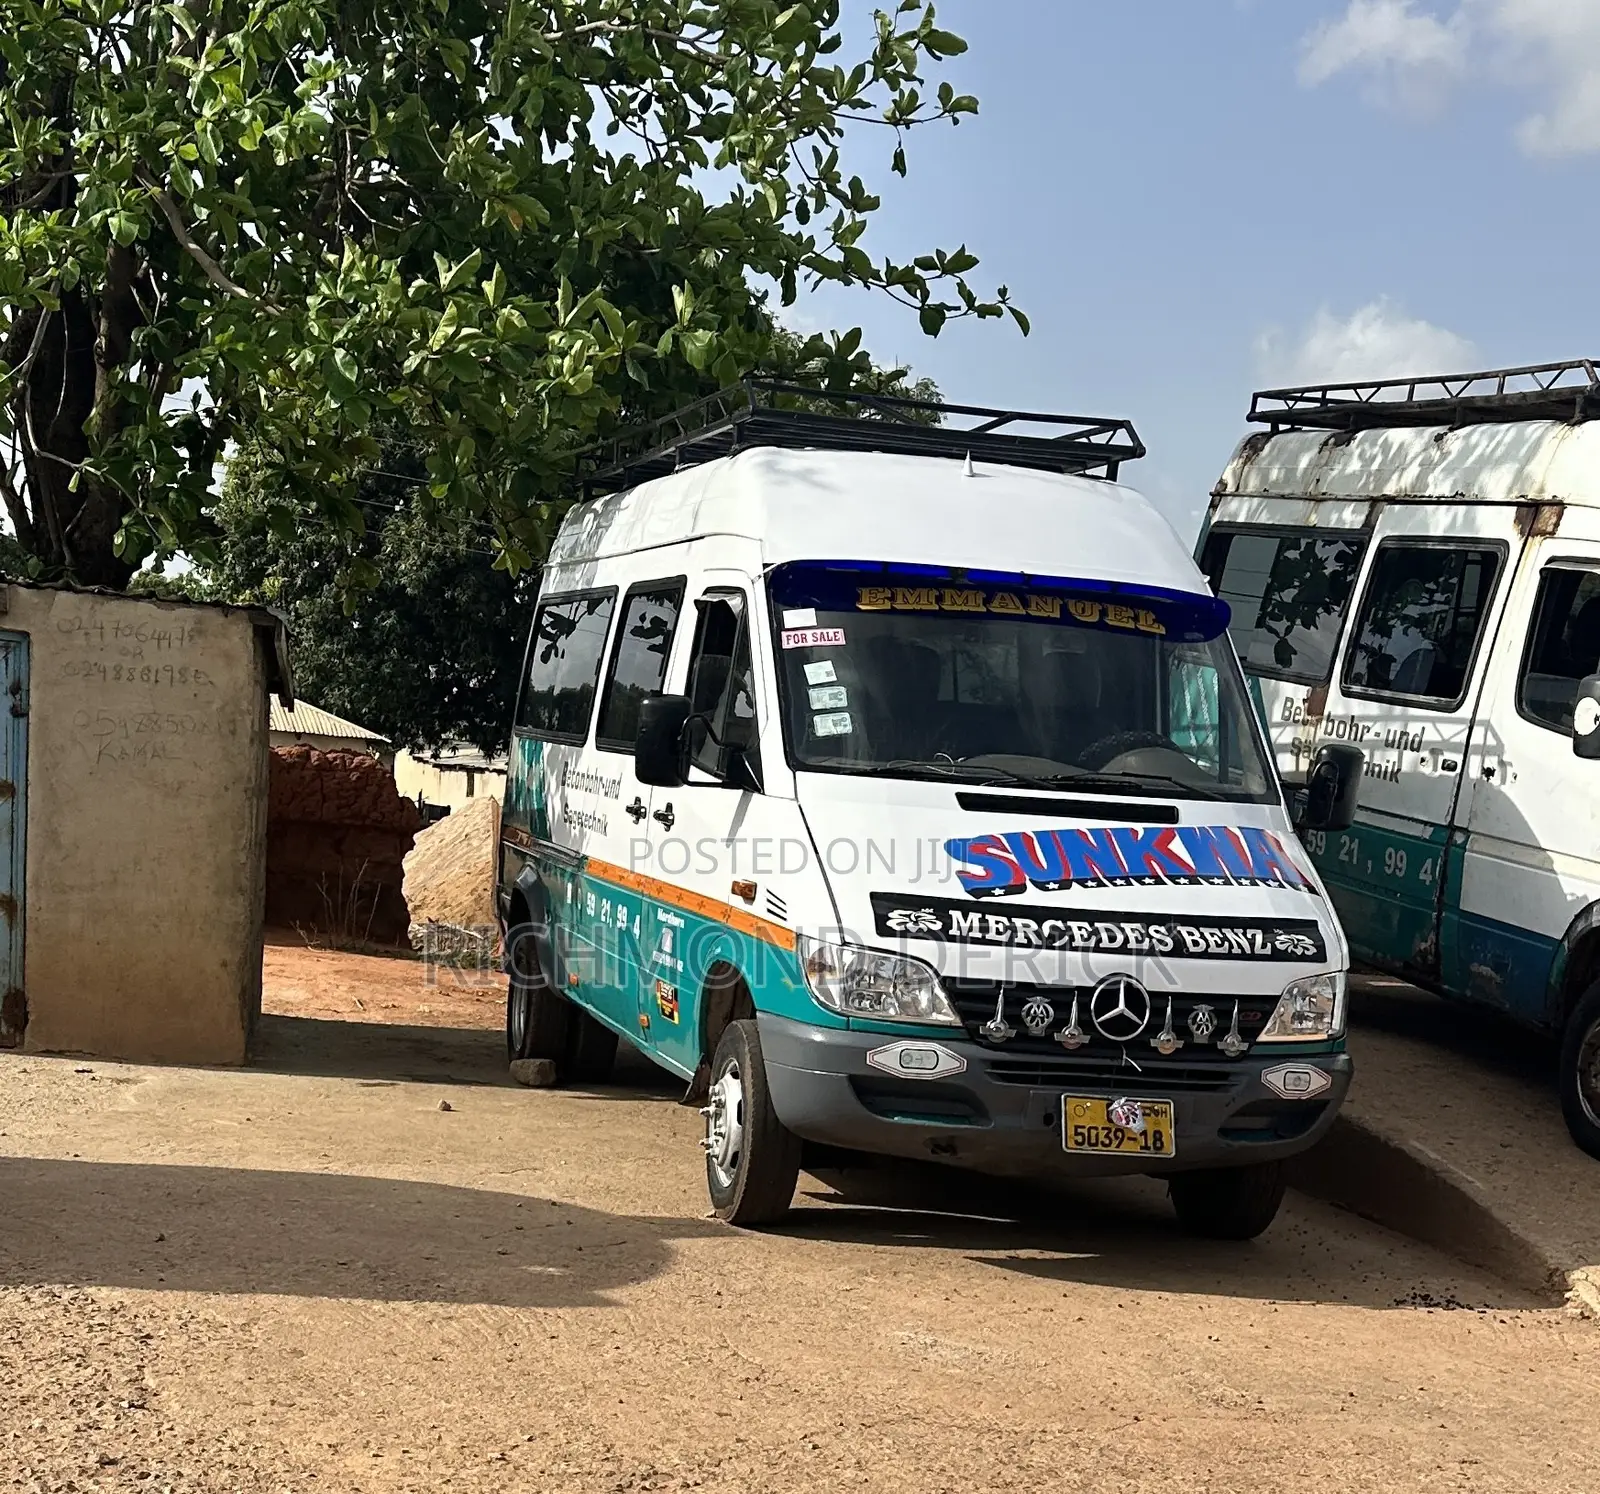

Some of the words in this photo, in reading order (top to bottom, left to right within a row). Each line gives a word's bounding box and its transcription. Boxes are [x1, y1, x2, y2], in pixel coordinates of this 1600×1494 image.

[856, 586, 1166, 634] EMMANUEL
[786, 633, 808, 645] FOR
[812, 630, 841, 643] SALE
[944, 825, 1320, 899] SUNKWA
[1306, 829, 1326, 855] 59
[1384, 847, 1407, 877] 99
[616, 903, 628, 931] 99
[632, 914, 641, 939] 4
[948, 910, 1174, 952] MERCEDES
[1177, 924, 1272, 955] BENZ
[1073, 1124, 1165, 1151] 5039-18
